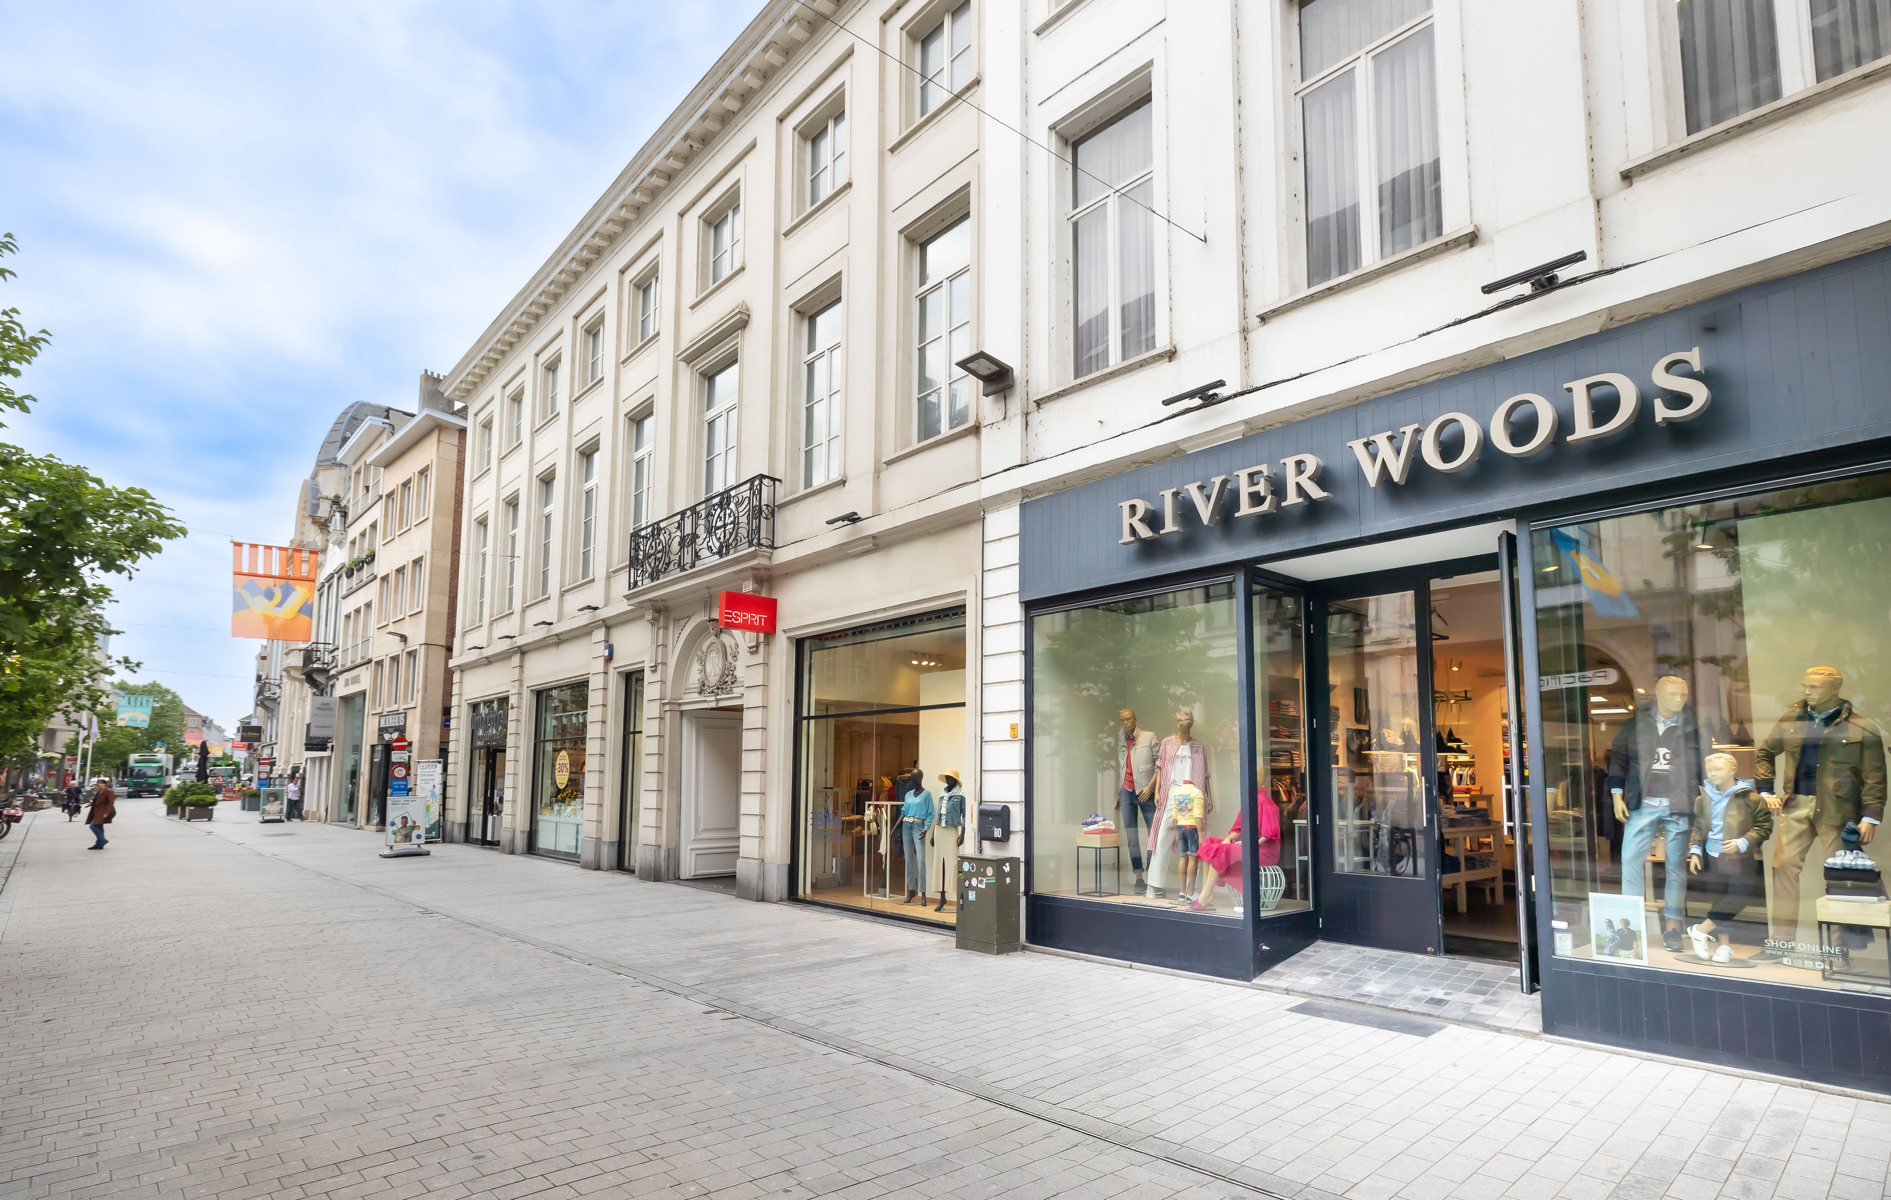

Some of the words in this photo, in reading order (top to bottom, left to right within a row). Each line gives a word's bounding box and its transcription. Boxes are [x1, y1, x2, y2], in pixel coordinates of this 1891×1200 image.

[1118, 452, 1332, 545] RIVER
[1347, 346, 1712, 488] WOODS
[724, 609, 768, 627] ESPRIT
[993, 827, 1002, 838] 80
[1764, 939, 1795, 949] SHOP
[1797, 942, 1842, 955] ONLINE
